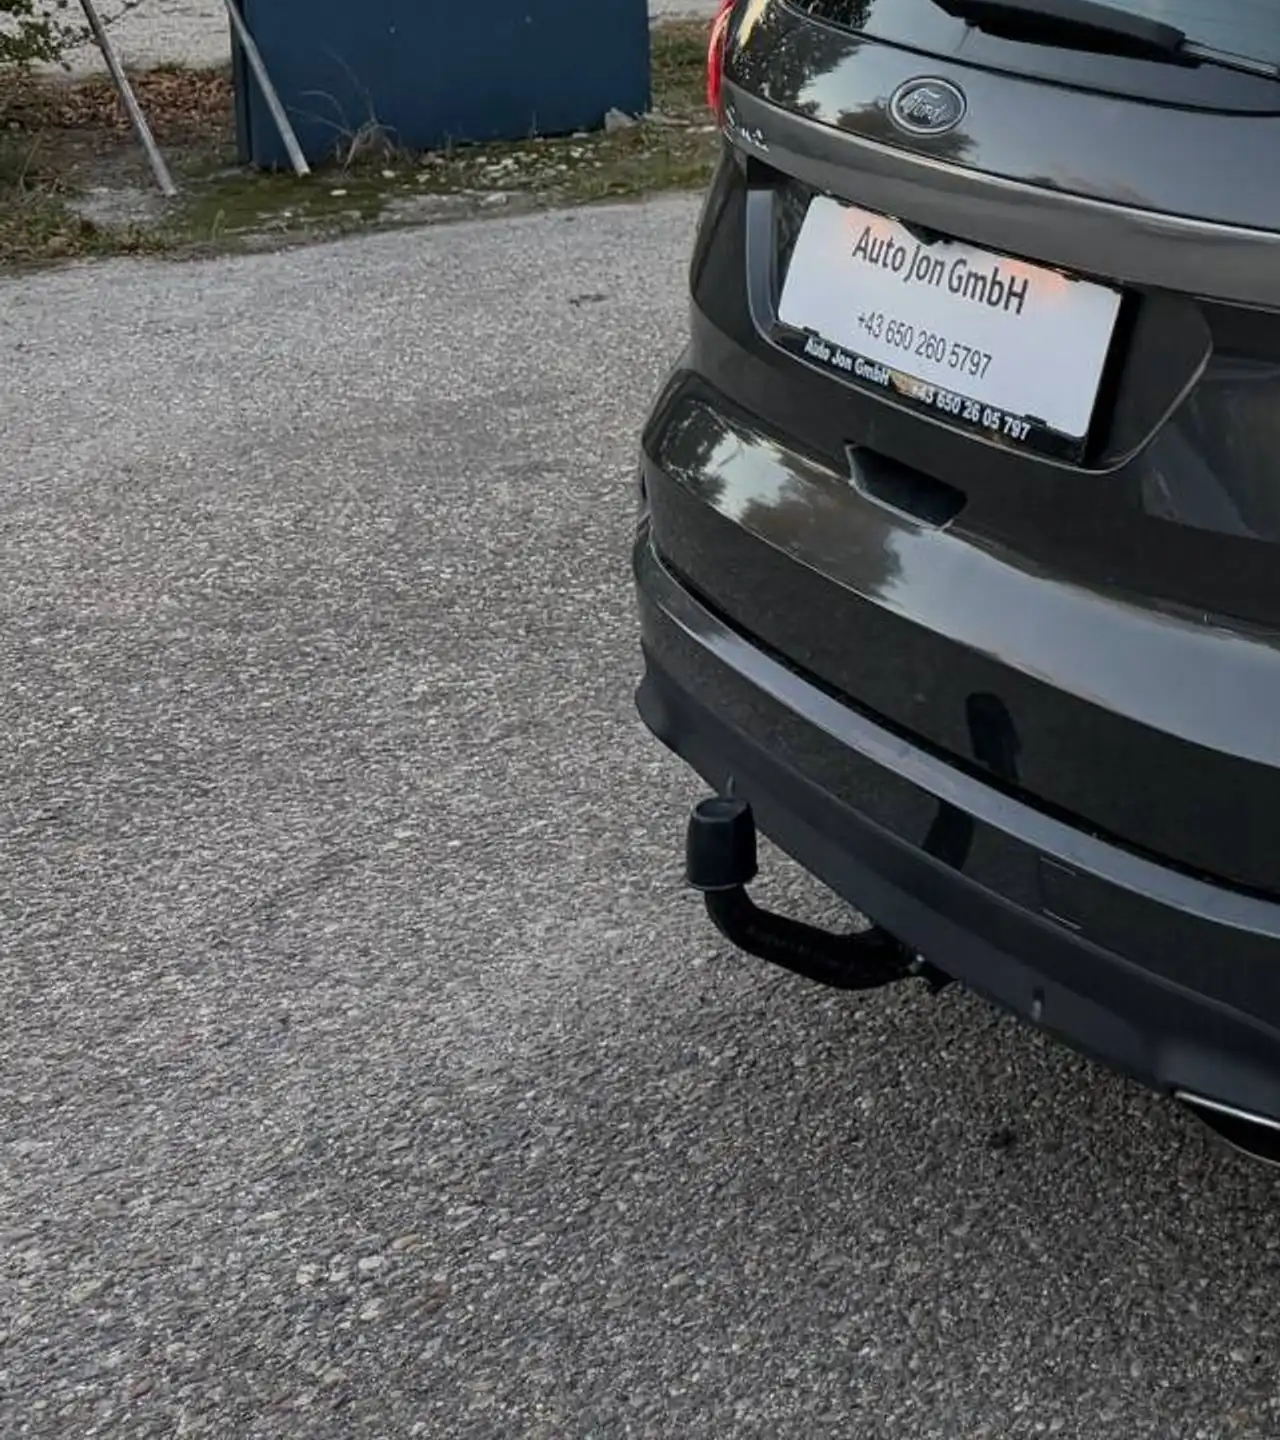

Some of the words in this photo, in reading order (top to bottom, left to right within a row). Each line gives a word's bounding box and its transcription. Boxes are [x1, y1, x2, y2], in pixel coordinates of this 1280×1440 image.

[852, 226, 906, 272] Auto
[903, 243, 945, 287] Jon
[948, 258, 1028, 314] GmbH
[804, 336, 831, 362] Auto
[831, 348, 851, 371] Jon
[854, 358, 890, 386] GmbH
[936, 391, 959, 415] 650
[963, 402, 979, 423] 26
[982, 409, 1000, 429] 05
[1003, 415, 1031, 441] 797
[858, 311, 884, 338] +43
[885, 319, 913, 350] 650
[915, 330, 946, 363] 260
[948, 343, 992, 379] 5797
